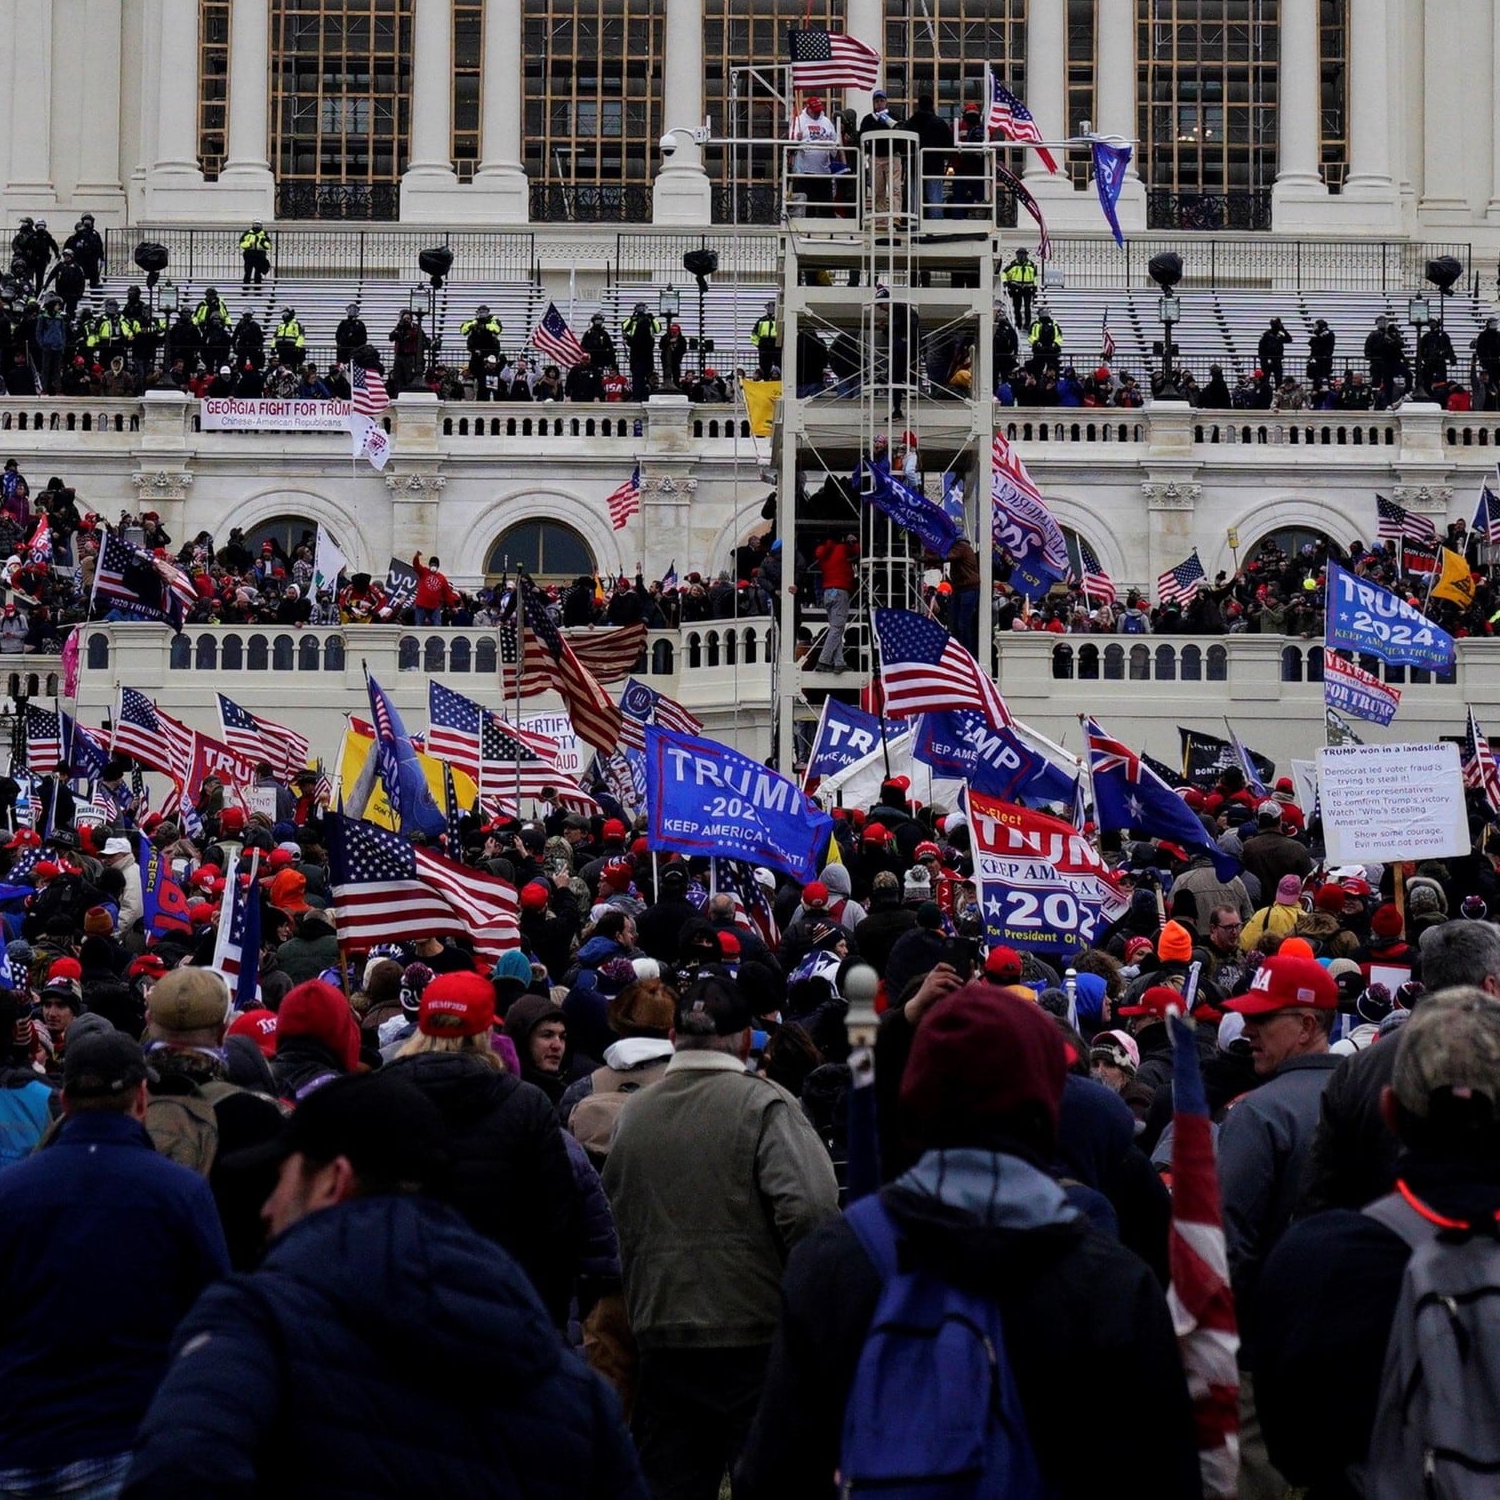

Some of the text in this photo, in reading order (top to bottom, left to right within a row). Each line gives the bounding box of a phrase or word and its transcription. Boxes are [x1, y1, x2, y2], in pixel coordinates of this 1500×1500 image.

[207, 402, 350, 416] GEORGIA FIGHT FOR TRUM
[221, 417, 342, 428] Chinese-American Republicans
[1353, 611, 1434, 646] 2024
[1349, 690, 1395, 717] TRUMP
[1324, 748, 1357, 756] TRUMP
[1404, 744, 1449, 752] landslide!
[1325, 767, 1367, 776] Democrat
[1370, 766, 1381, 774] led
[1386, 766, 1407, 774] voter
[1410, 764, 1433, 772] fraud
[1338, 774, 1410, 786] trying to steal it!
[1326, 786, 1433, 799] Tell your representatives
[1333, 799, 1341, 807] to
[1383, 796, 1417, 806] Trump's
[1391, 805, 1426, 815] Stealing
[664, 819, 763, 843] KEEP AMERICA
[1354, 830, 1377, 839] Show
[1380, 829, 1403, 837] some
[1355, 840, 1370, 849] Evil
[1373, 840, 1395, 848] must
[1398, 838, 1412, 847] not
[980, 858, 1020, 877] KEEP
[987, 925, 1001, 935] For
[1005, 928, 1057, 942] President
